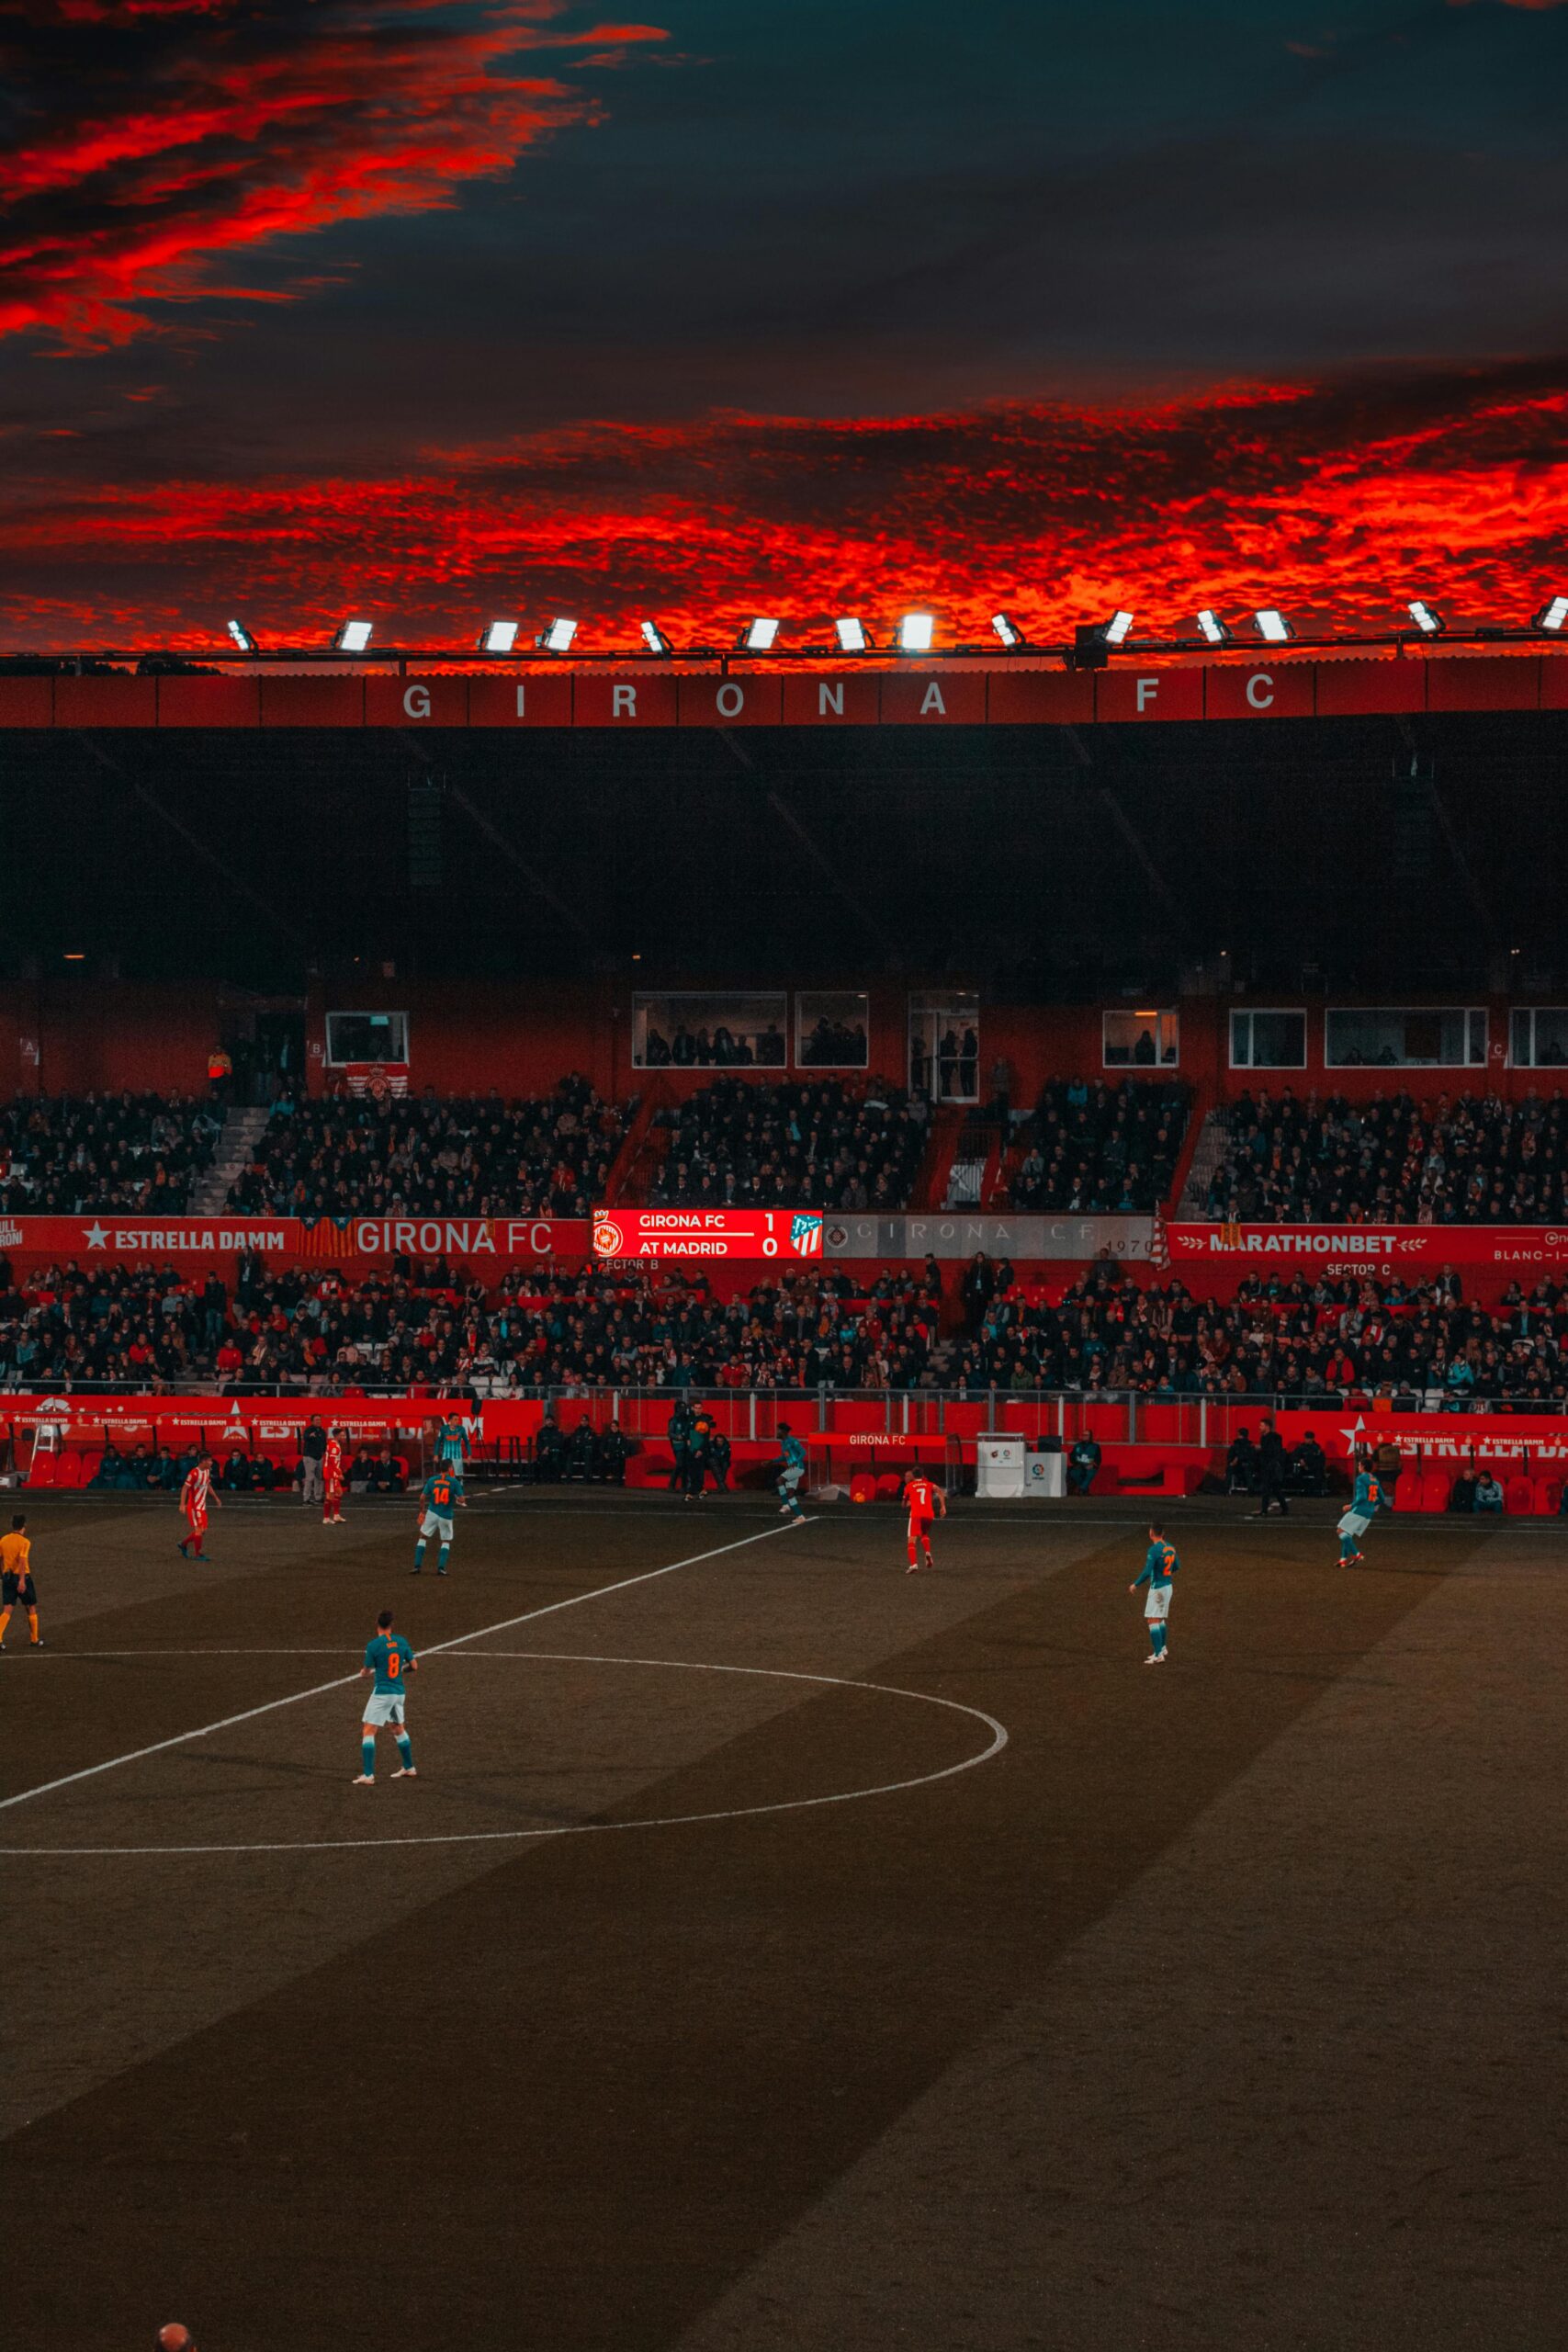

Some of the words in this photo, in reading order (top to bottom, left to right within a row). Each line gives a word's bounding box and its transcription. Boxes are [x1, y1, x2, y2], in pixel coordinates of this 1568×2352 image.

[402, 682, 946, 719] GIRONA
[1135, 673, 1275, 713] FC
[312, 1043, 321, 1054] B
[1494, 1044, 1503, 1055] C
[639, 1214, 701, 1227] GIRONA
[705, 1214, 725, 1227] FC
[764, 1213, 773, 1232] 1
[857, 1223, 1010, 1240] GIRONA
[115, 1230, 216, 1250] ESTRELLA
[220, 1231, 285, 1250] DAMM
[357, 1222, 495, 1253] GIRONA
[508, 1223, 552, 1253] FC
[1105, 1240, 1154, 1253] 1970
[1210, 1234, 1397, 1253] MARATHONBET
[639, 1241, 661, 1255] AT
[663, 1241, 728, 1255] MADRID
[761, 1238, 778, 1256] 0
[604, 1259, 645, 1270] ECTOR
[650, 1259, 659, 1270] B
[1327, 1263, 1375, 1275] SECTOR
[1382, 1263, 1391, 1275] C
[850, 1434, 890, 1445] GIRONA
[892, 1434, 906, 1446] FC
[433, 1487, 449, 1506] 14
[916, 1487, 926, 1505] 7
[388, 1652, 400, 1679] 8
